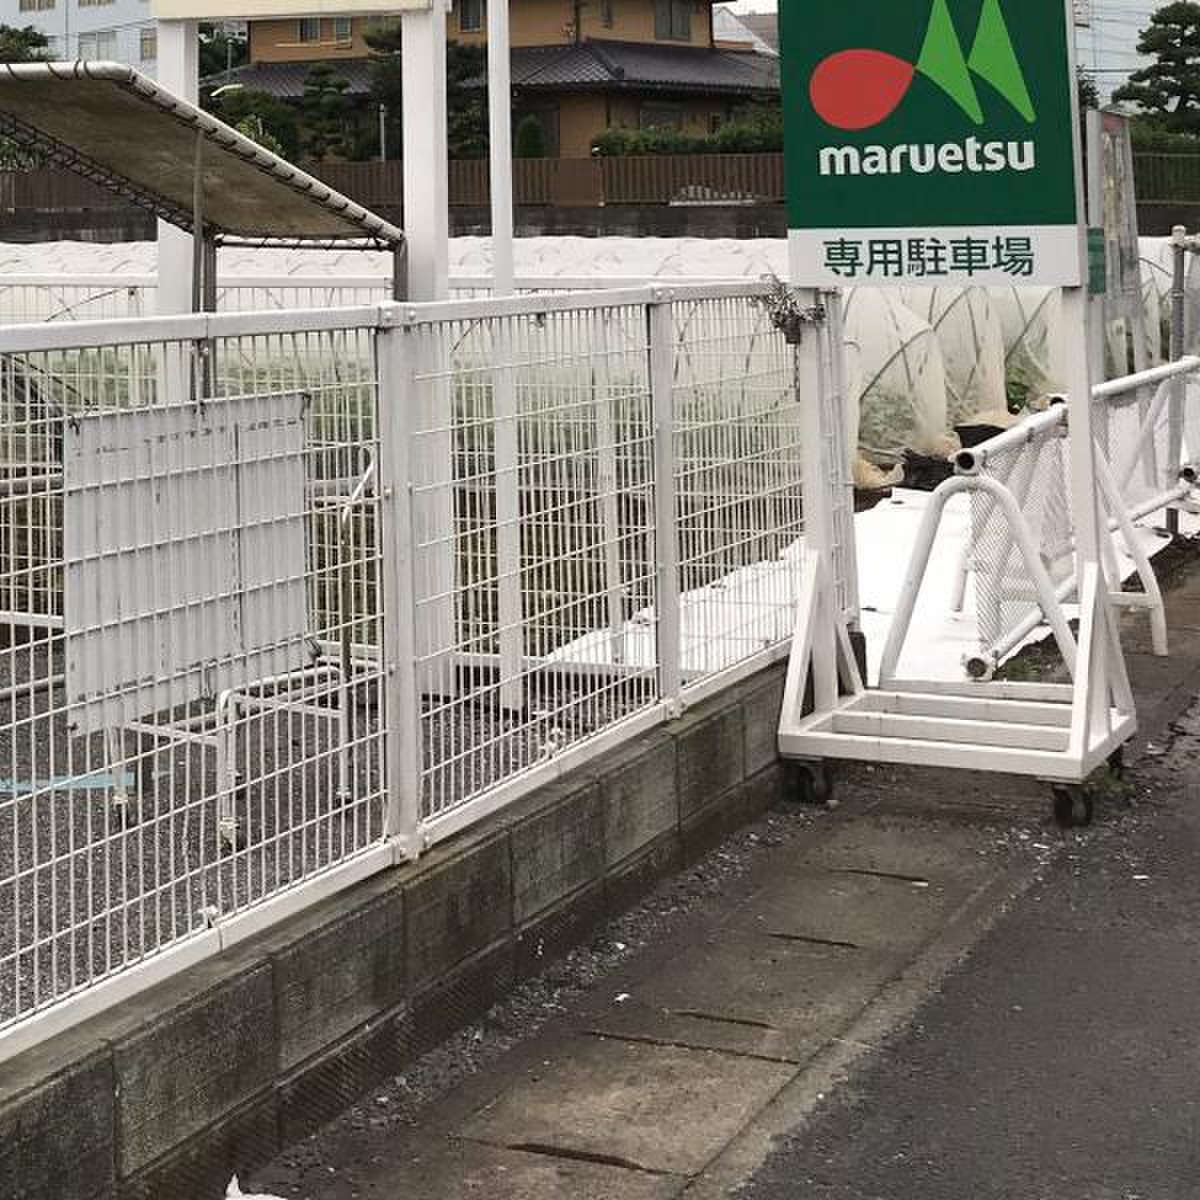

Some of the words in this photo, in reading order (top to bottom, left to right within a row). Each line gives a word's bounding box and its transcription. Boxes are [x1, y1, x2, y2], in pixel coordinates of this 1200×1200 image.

[819, 136, 1035, 176] maruetsu
[822, 235, 1035, 277] 専用駐車場
